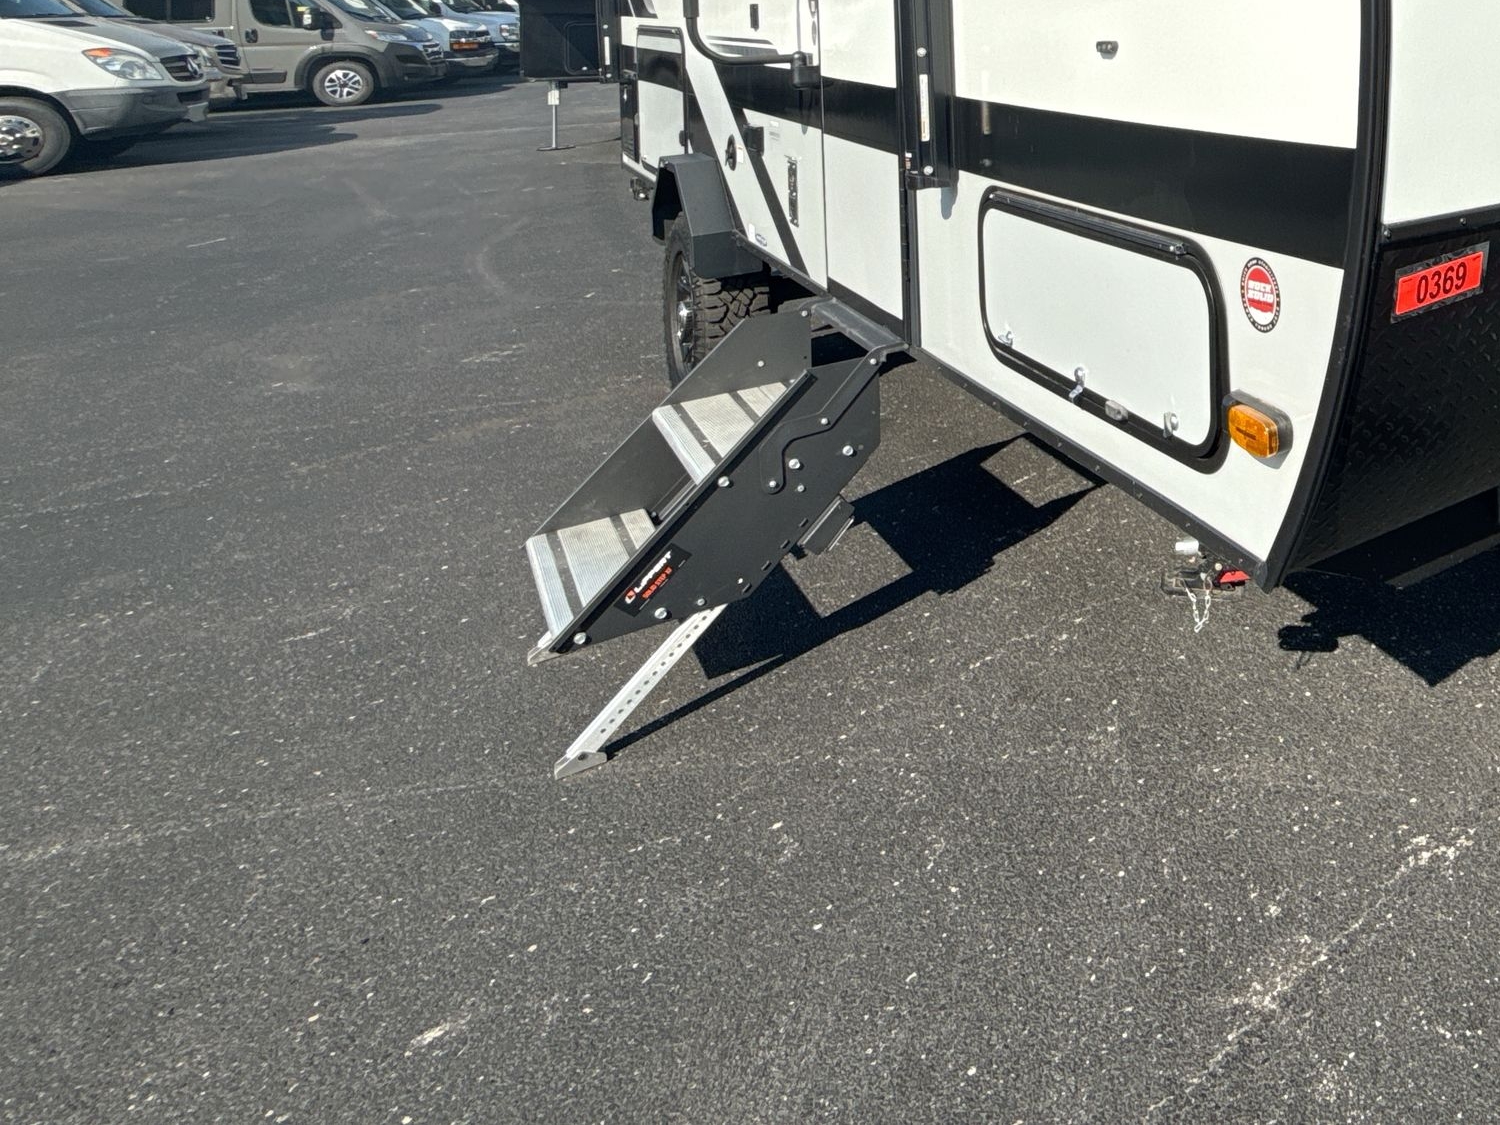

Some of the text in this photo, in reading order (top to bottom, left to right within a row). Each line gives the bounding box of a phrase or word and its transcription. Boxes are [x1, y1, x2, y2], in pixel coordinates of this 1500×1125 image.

[1247, 280, 1272, 293] ROCK
[1416, 262, 1467, 304] 0369
[1247, 289, 1274, 303] SOLID
